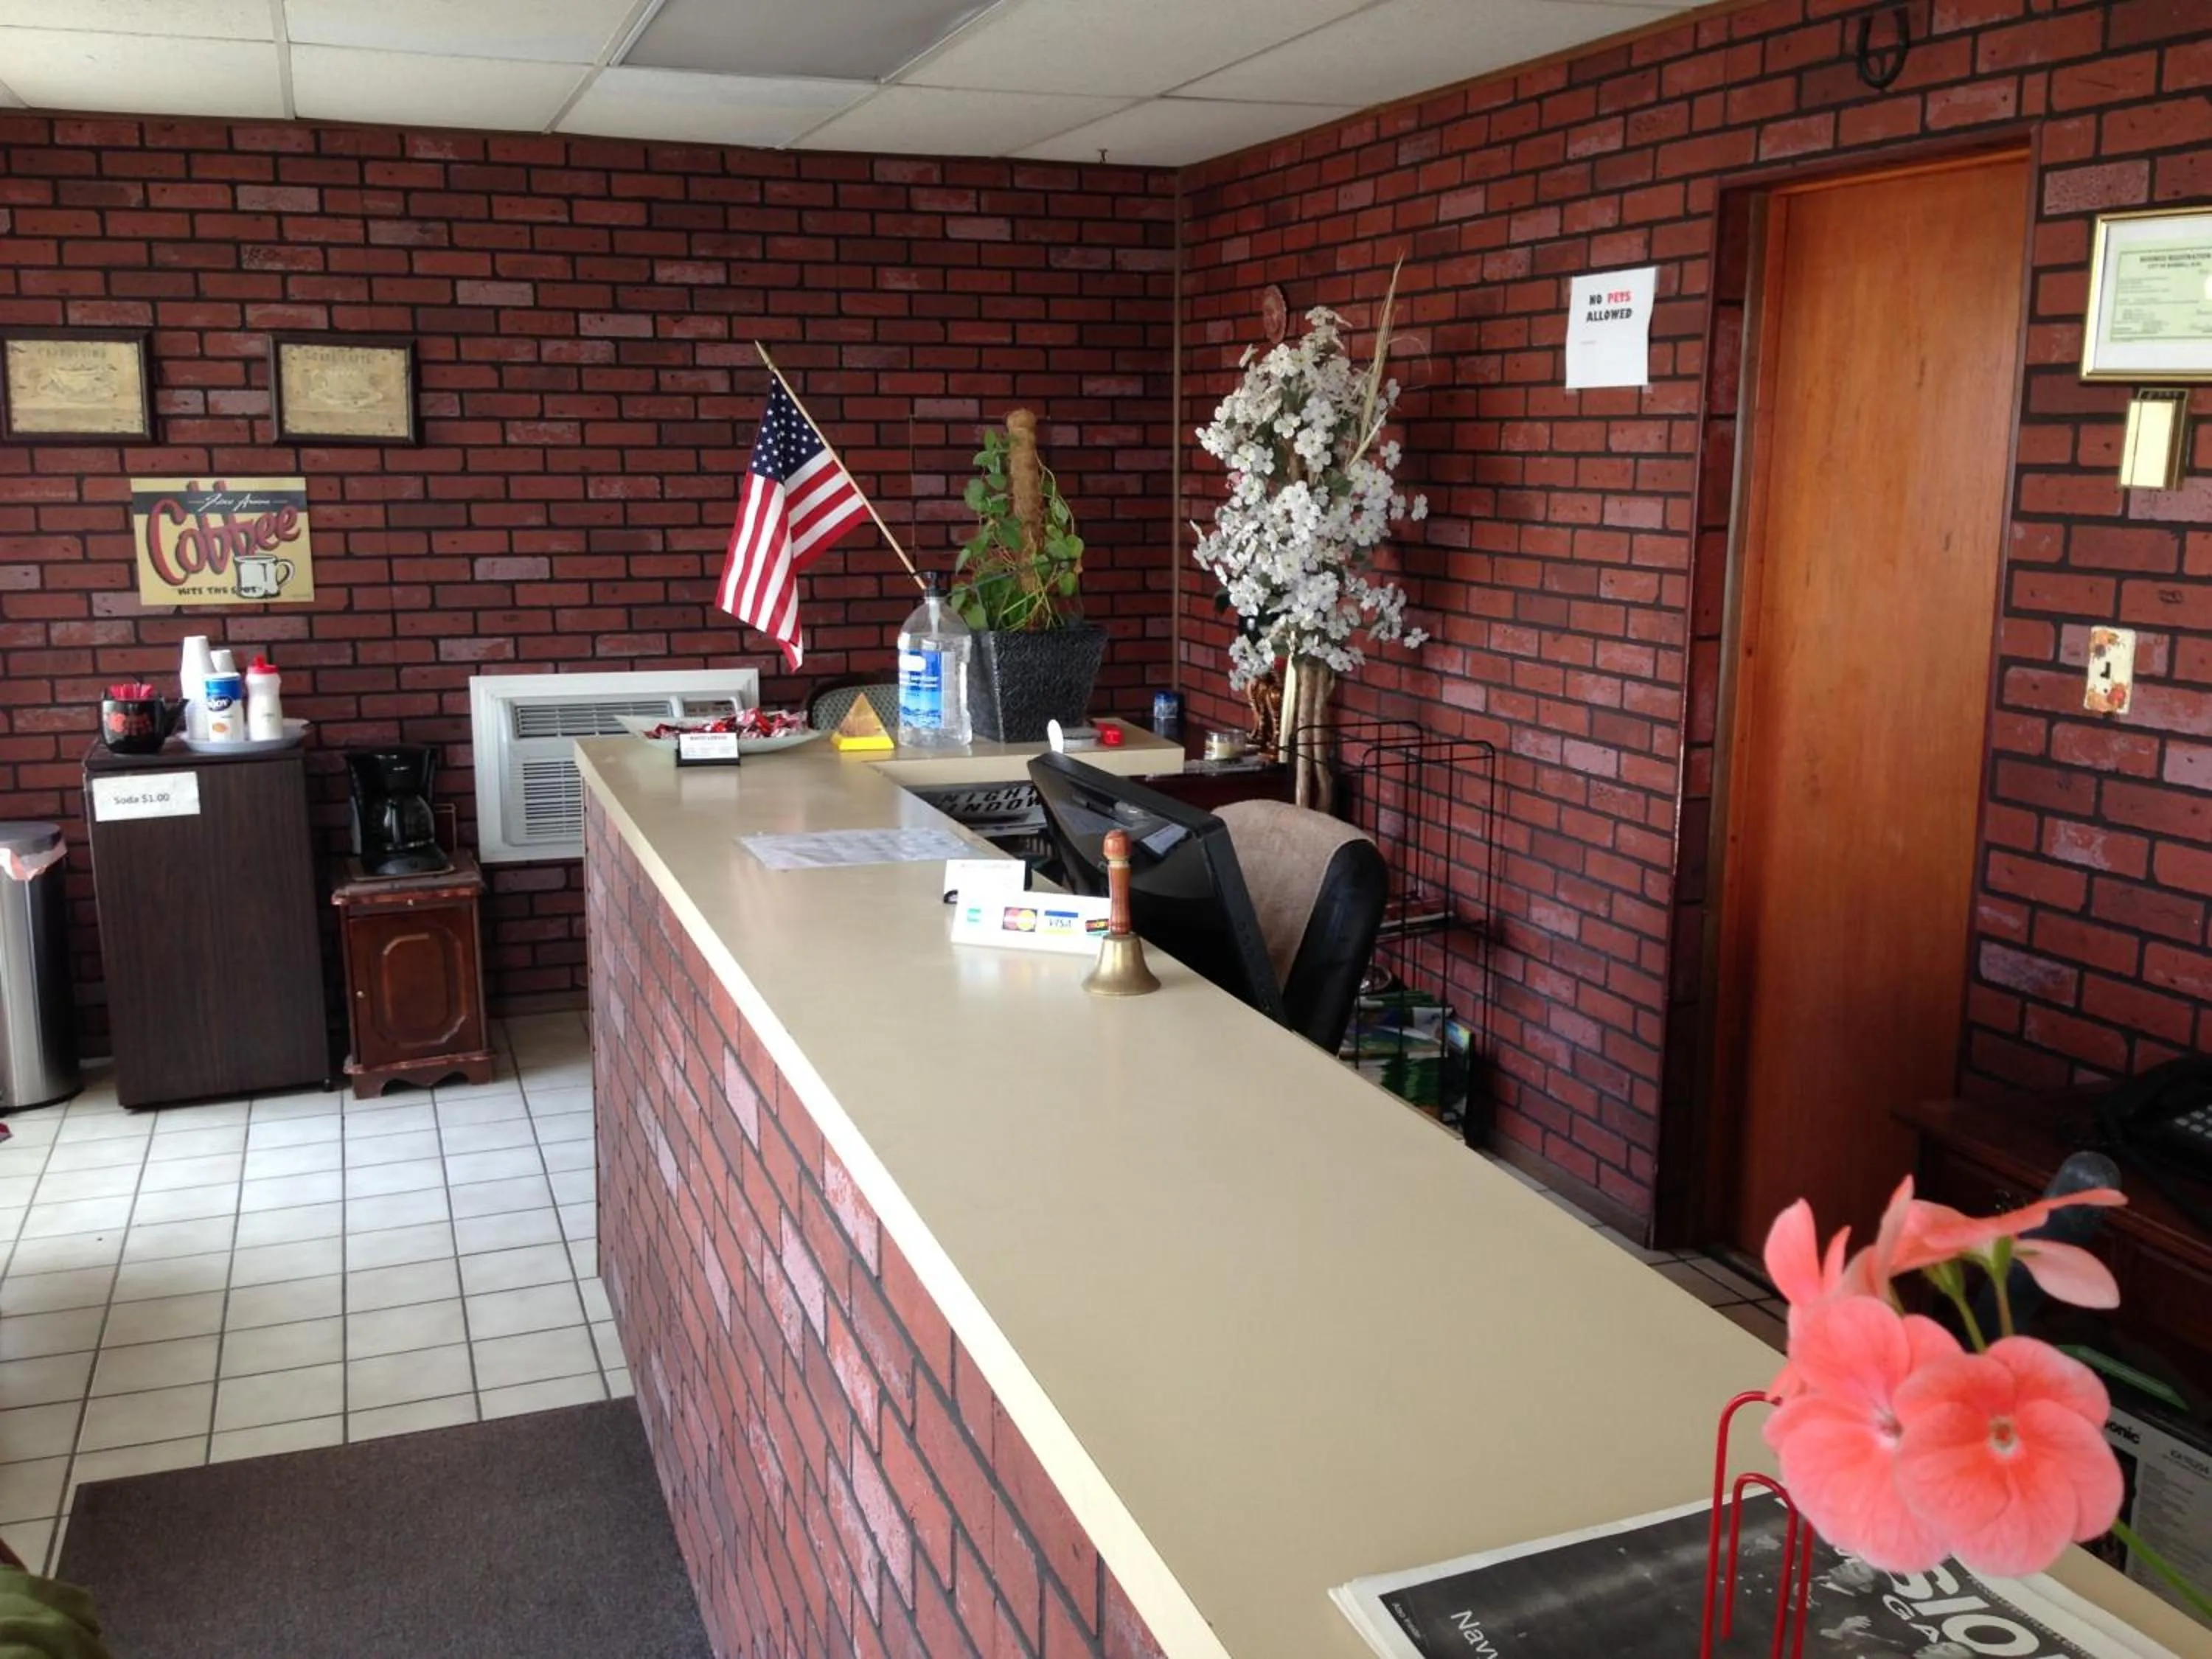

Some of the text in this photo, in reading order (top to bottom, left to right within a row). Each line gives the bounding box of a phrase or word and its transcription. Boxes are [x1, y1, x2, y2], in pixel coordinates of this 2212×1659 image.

[1589, 291, 1632, 305] NO PETS
[1586, 307, 1632, 321] ALLOWED
[114, 793, 170, 805] Soda $1.00
[936, 797, 1042, 813] INDOW
[1049, 919, 1072, 928] VISA
[2105, 1422, 2141, 1445] onic
